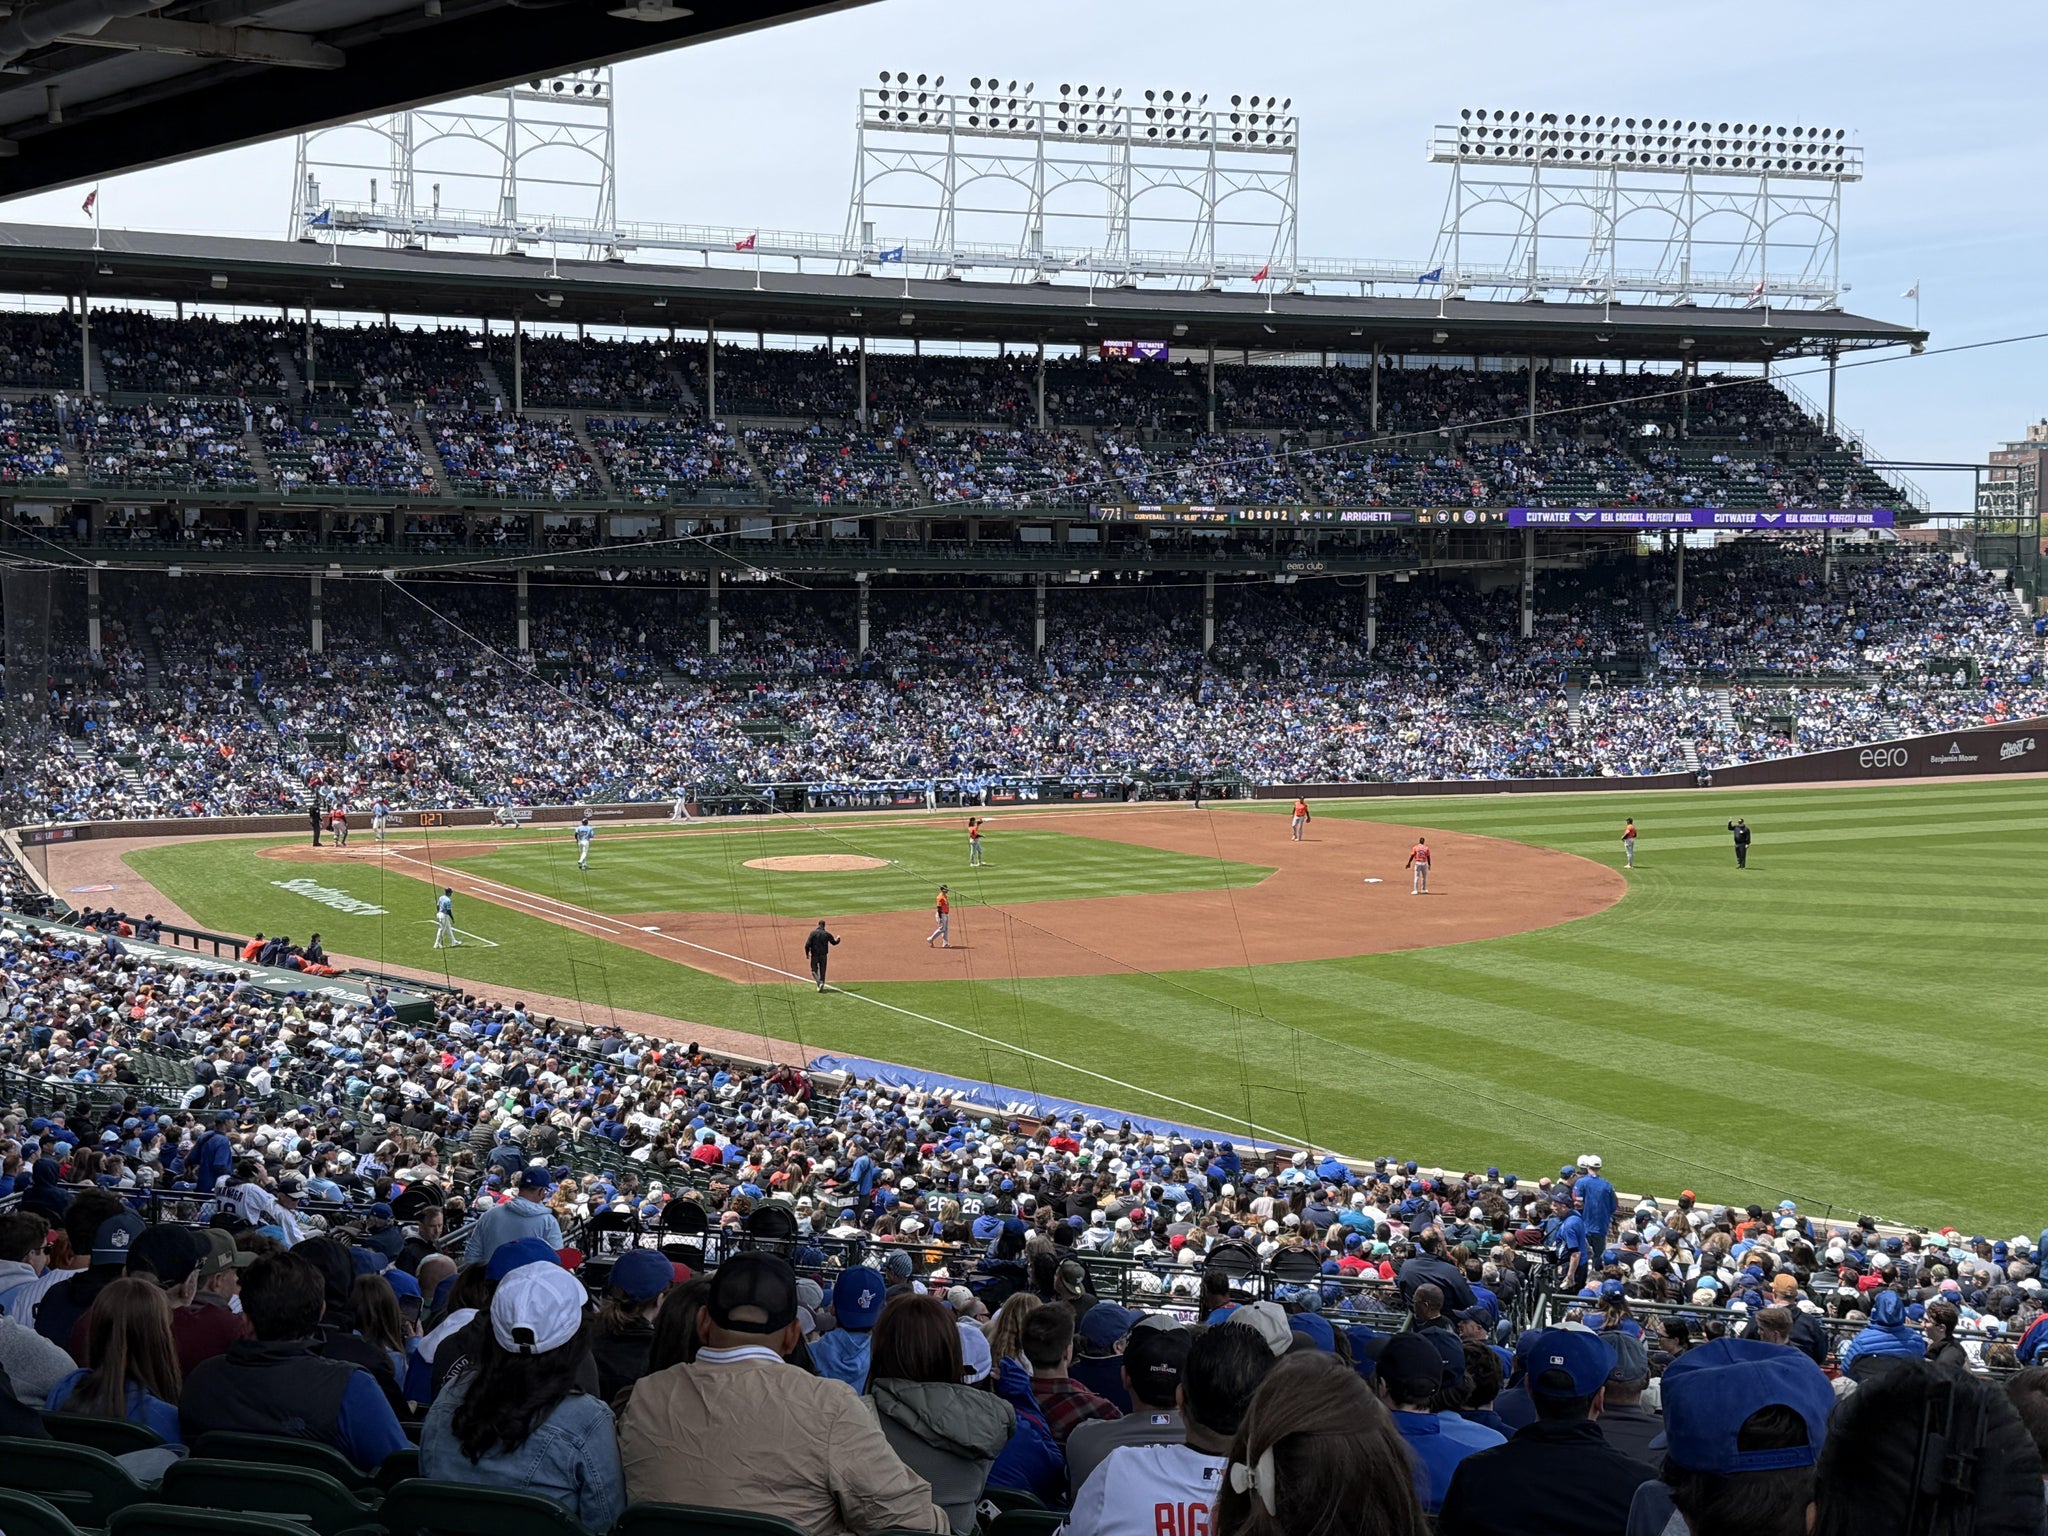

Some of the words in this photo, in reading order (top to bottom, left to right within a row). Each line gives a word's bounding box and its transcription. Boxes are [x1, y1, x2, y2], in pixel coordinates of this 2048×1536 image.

[1100, 508, 1115, 520] 77
[1248, 510, 1254, 520] 0
[1264, 510, 1271, 520] 0
[1281, 510, 1287, 520] 2
[1341, 511, 1391, 521] ARRIGHETTI
[1453, 512, 1459, 522] 0
[1480, 512, 1486, 522] 0
[1526, 512, 1571, 522] CUTWATER
[1601, 513, 1614, 522] REAL
[1616, 513, 1645, 522] COCKTAILS.
[1646, 513, 1674, 522] PERFECTLY
[1714, 513, 1756, 523] CUTWATER
[1786, 514, 1798, 523] REAL
[1800, 514, 1828, 523] COCKTAILS.
[1829, 514, 1856, 523] PERFECTLY
[1306, 561, 1324, 570] club
[1859, 747, 1908, 768] eero
[1930, 755, 1958, 765] Benjamin
[1958, 754, 1978, 762] Moore
[962, 1198, 982, 1214] 26
